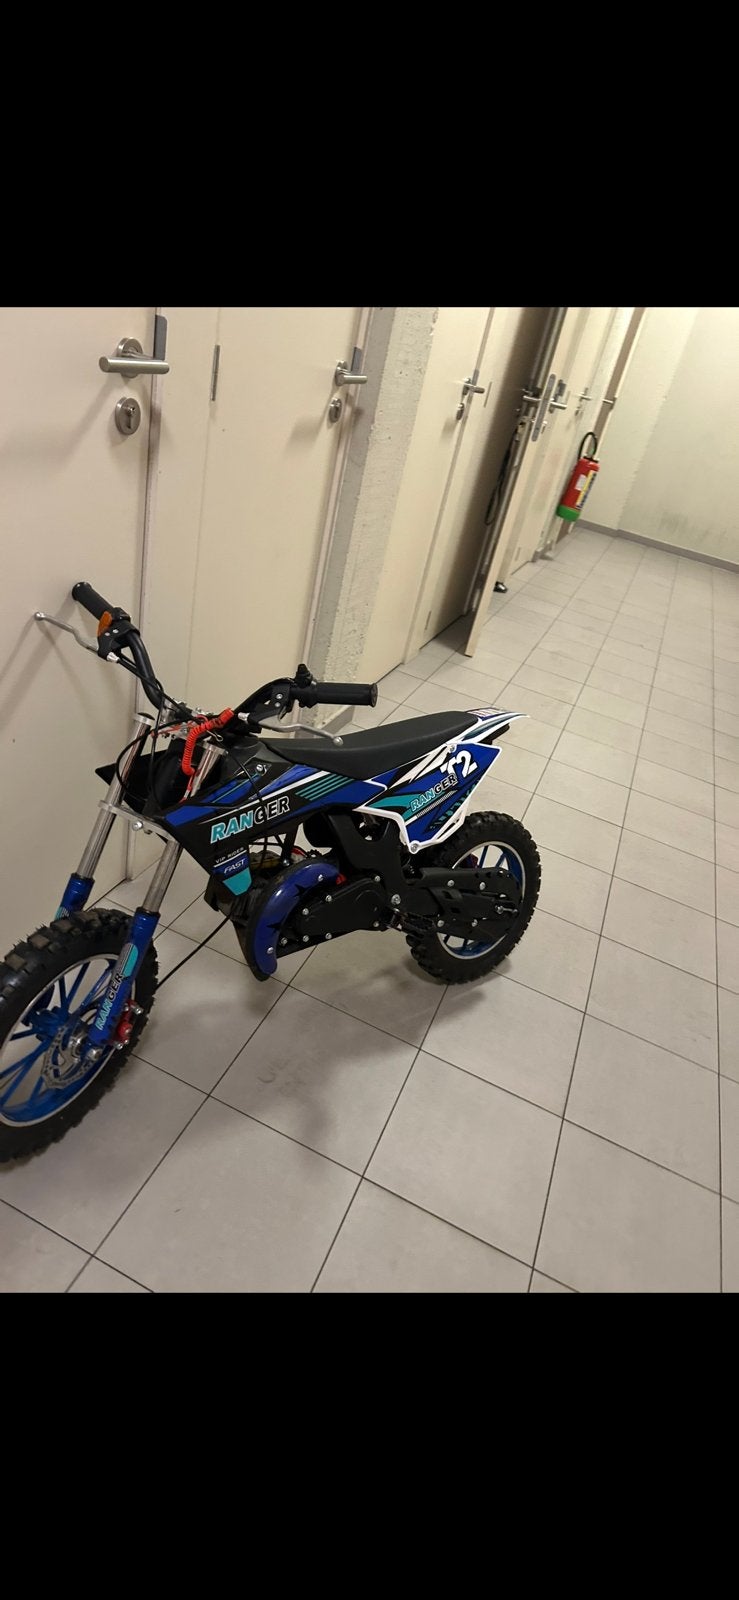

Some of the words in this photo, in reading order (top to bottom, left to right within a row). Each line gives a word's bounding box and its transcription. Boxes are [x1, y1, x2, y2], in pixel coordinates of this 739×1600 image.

[410, 773, 458, 812] RANGER
[210, 796, 291, 844] RANGER
[223, 858, 246, 874] FAST
[94, 973, 123, 1031] RANGER
